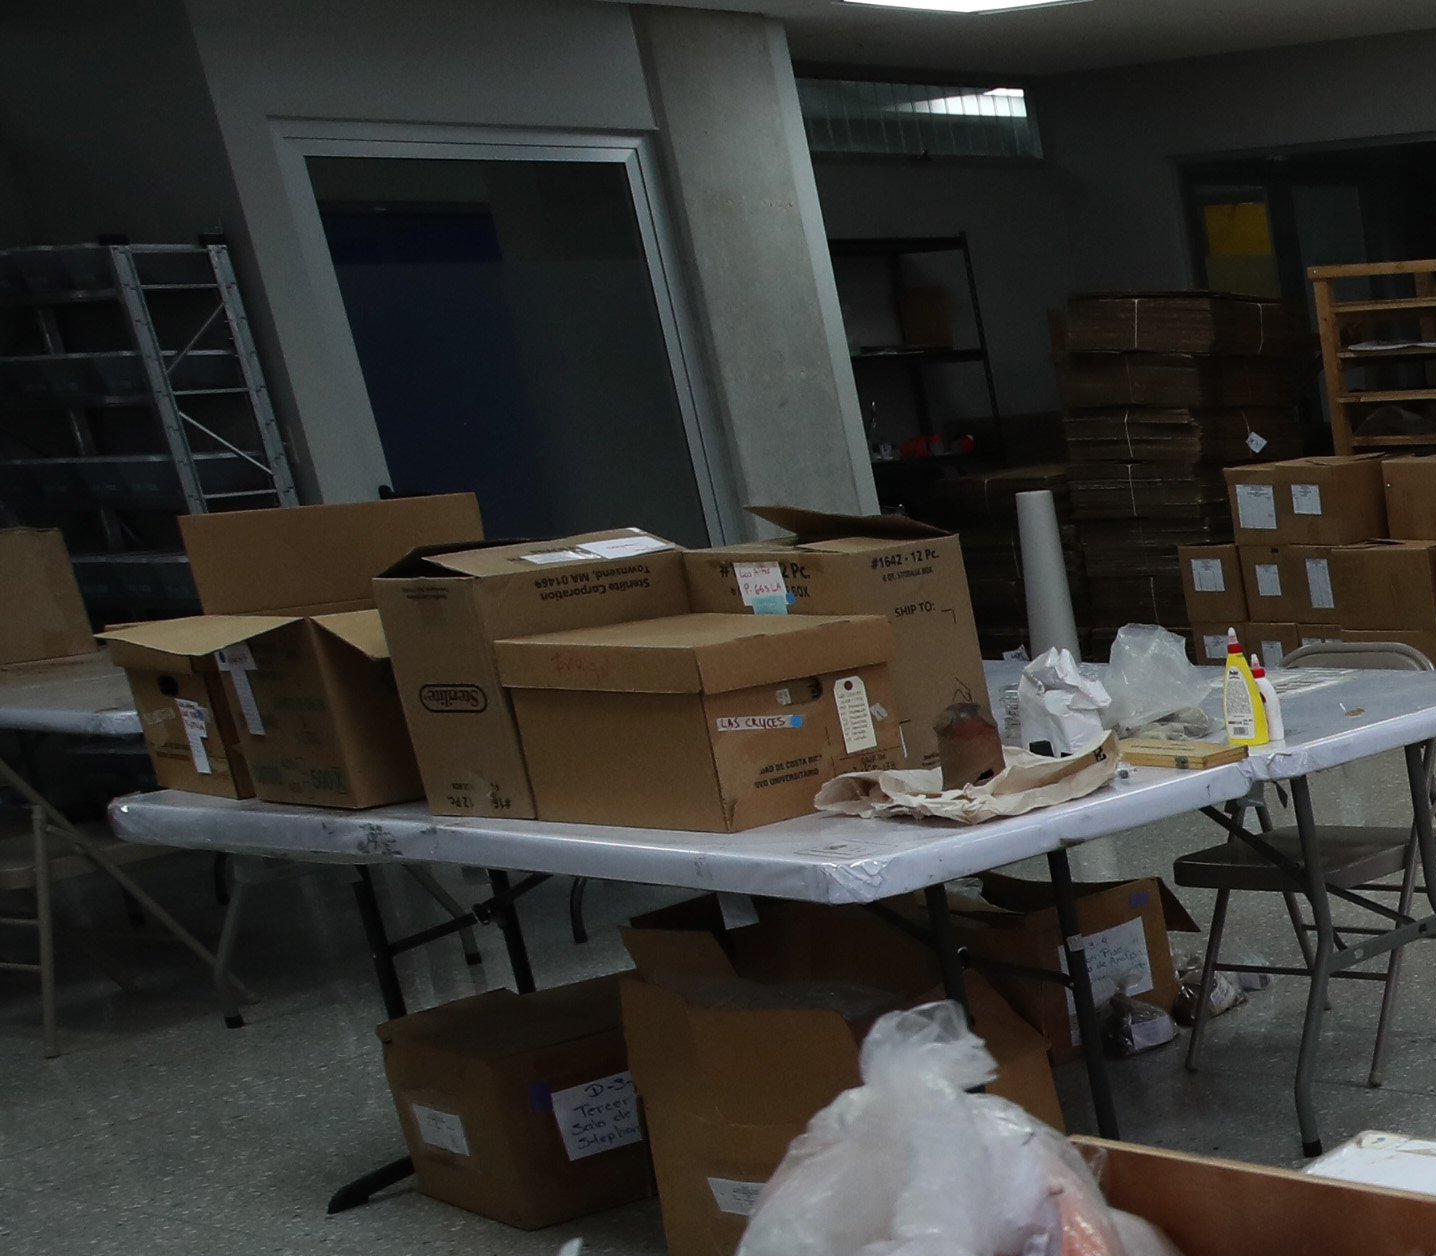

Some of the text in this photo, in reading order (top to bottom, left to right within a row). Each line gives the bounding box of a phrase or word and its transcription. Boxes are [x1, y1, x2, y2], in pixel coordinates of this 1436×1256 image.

[871, 553, 902, 569] #1642
[911, 551, 924, 562] 12
[925, 549, 940, 560] Pc.
[534, 563, 651, 589] Townsend, MA 01469
[790, 562, 811, 579] Pc.
[540, 577, 651, 601] Sterilite Corporation
[895, 601, 936, 618] SHIP TO:
[427, 690, 479, 707] Sterilite
[720, 715, 786, 730] LAS CRUCES
[574, 1096, 630, 1118] Tercer
[613, 1109, 632, 1122] de
